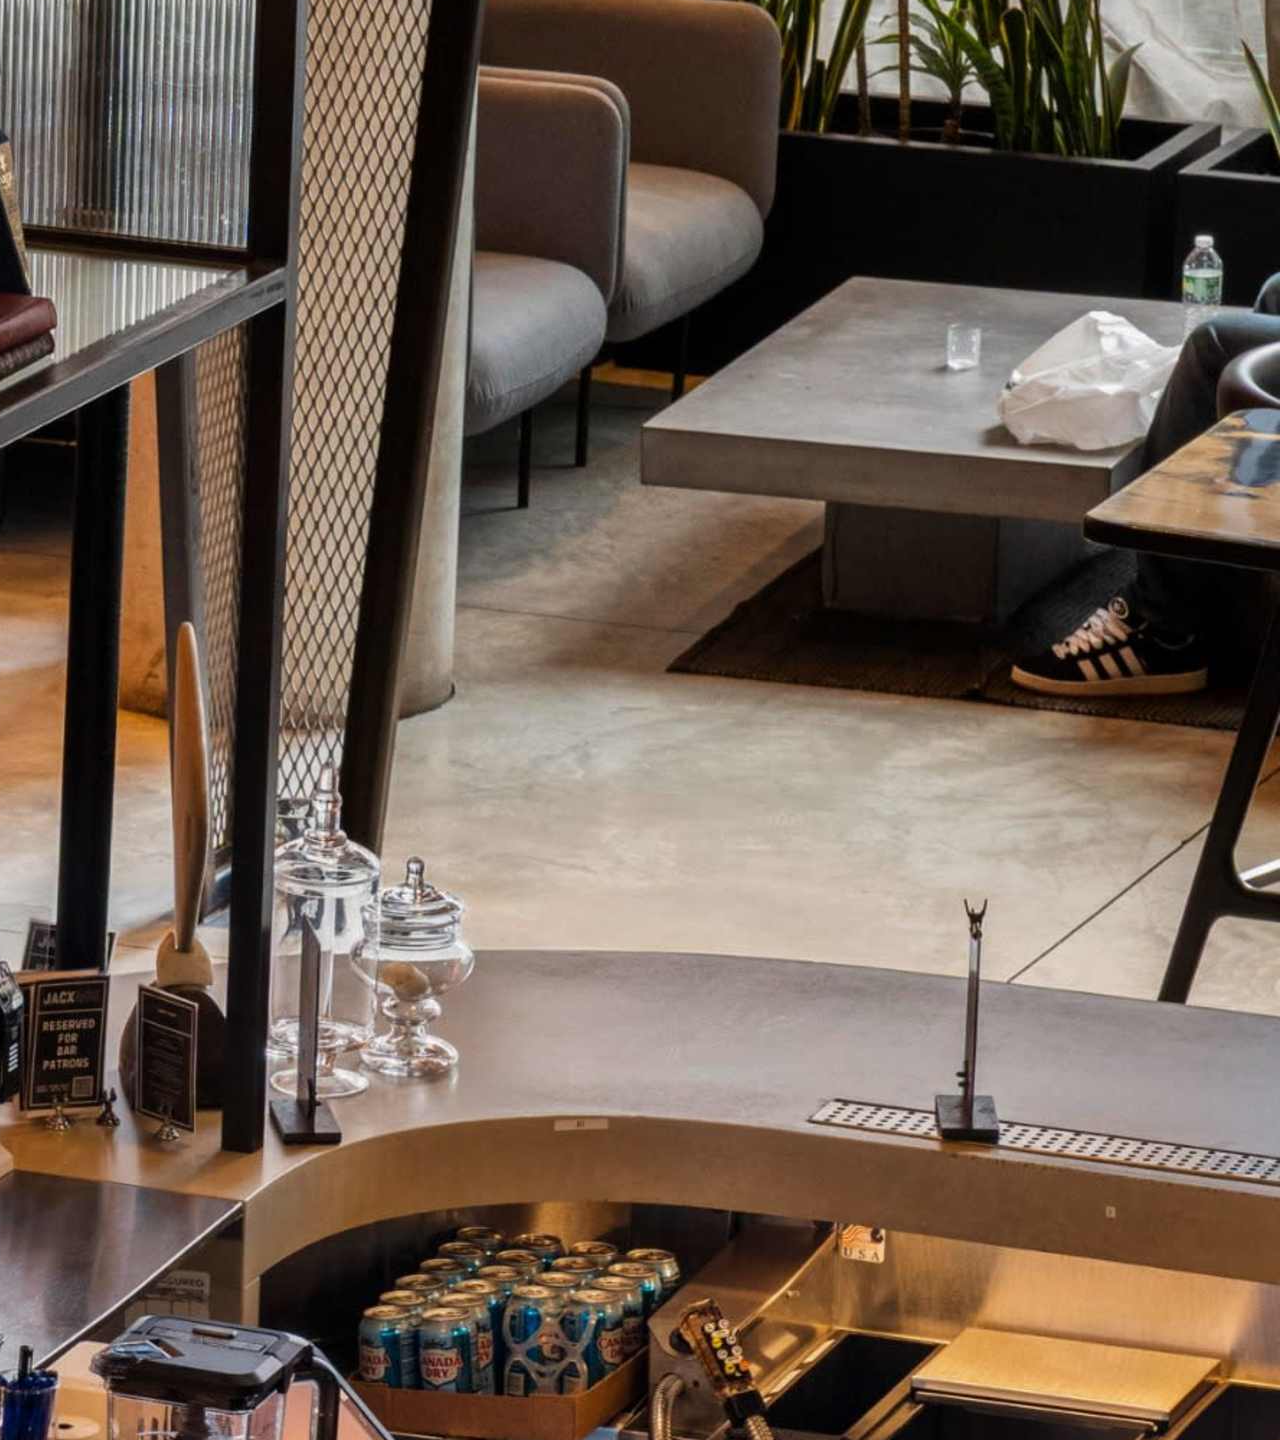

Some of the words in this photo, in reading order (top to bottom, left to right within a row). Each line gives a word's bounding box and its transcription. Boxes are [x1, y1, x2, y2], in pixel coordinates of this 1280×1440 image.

[42, 1018, 96, 1032] RESERVED
[57, 1032, 78, 1044] FOR
[56, 1045, 78, 1057] BAR
[42, 1059, 89, 1071] PATRONS
